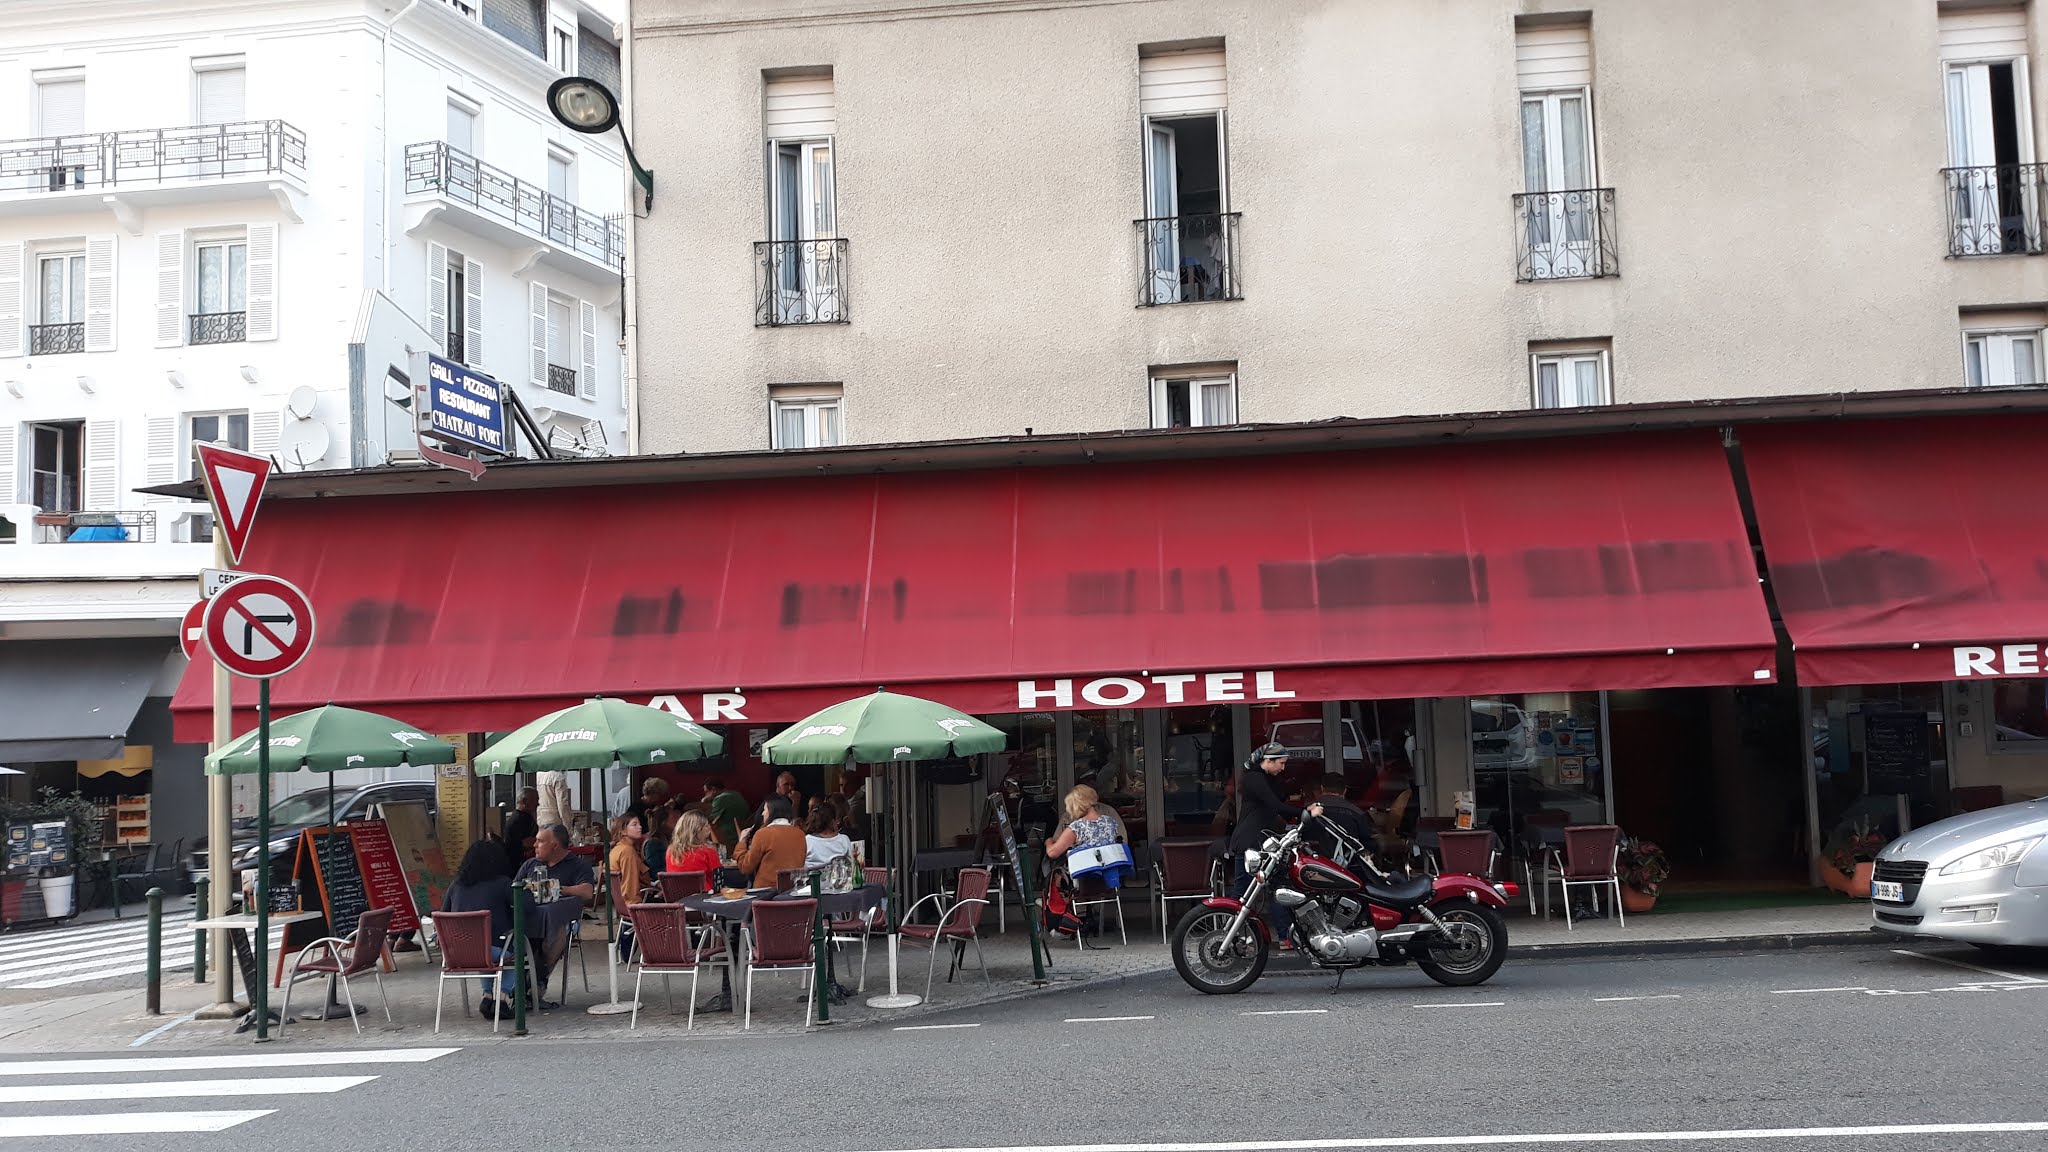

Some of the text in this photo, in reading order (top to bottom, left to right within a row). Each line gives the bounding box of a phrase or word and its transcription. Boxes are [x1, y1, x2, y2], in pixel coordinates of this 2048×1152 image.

[430, 361, 455, 385] GRILL
[463, 375, 498, 402] PIZZERIA
[439, 387, 491, 420] RESTAURANT
[432, 409, 501, 446] CHATEAU FORT
[1953, 644, 2048, 676] RE
[584, 693, 749, 721] AR
[1018, 671, 1296, 708] HOTEL
